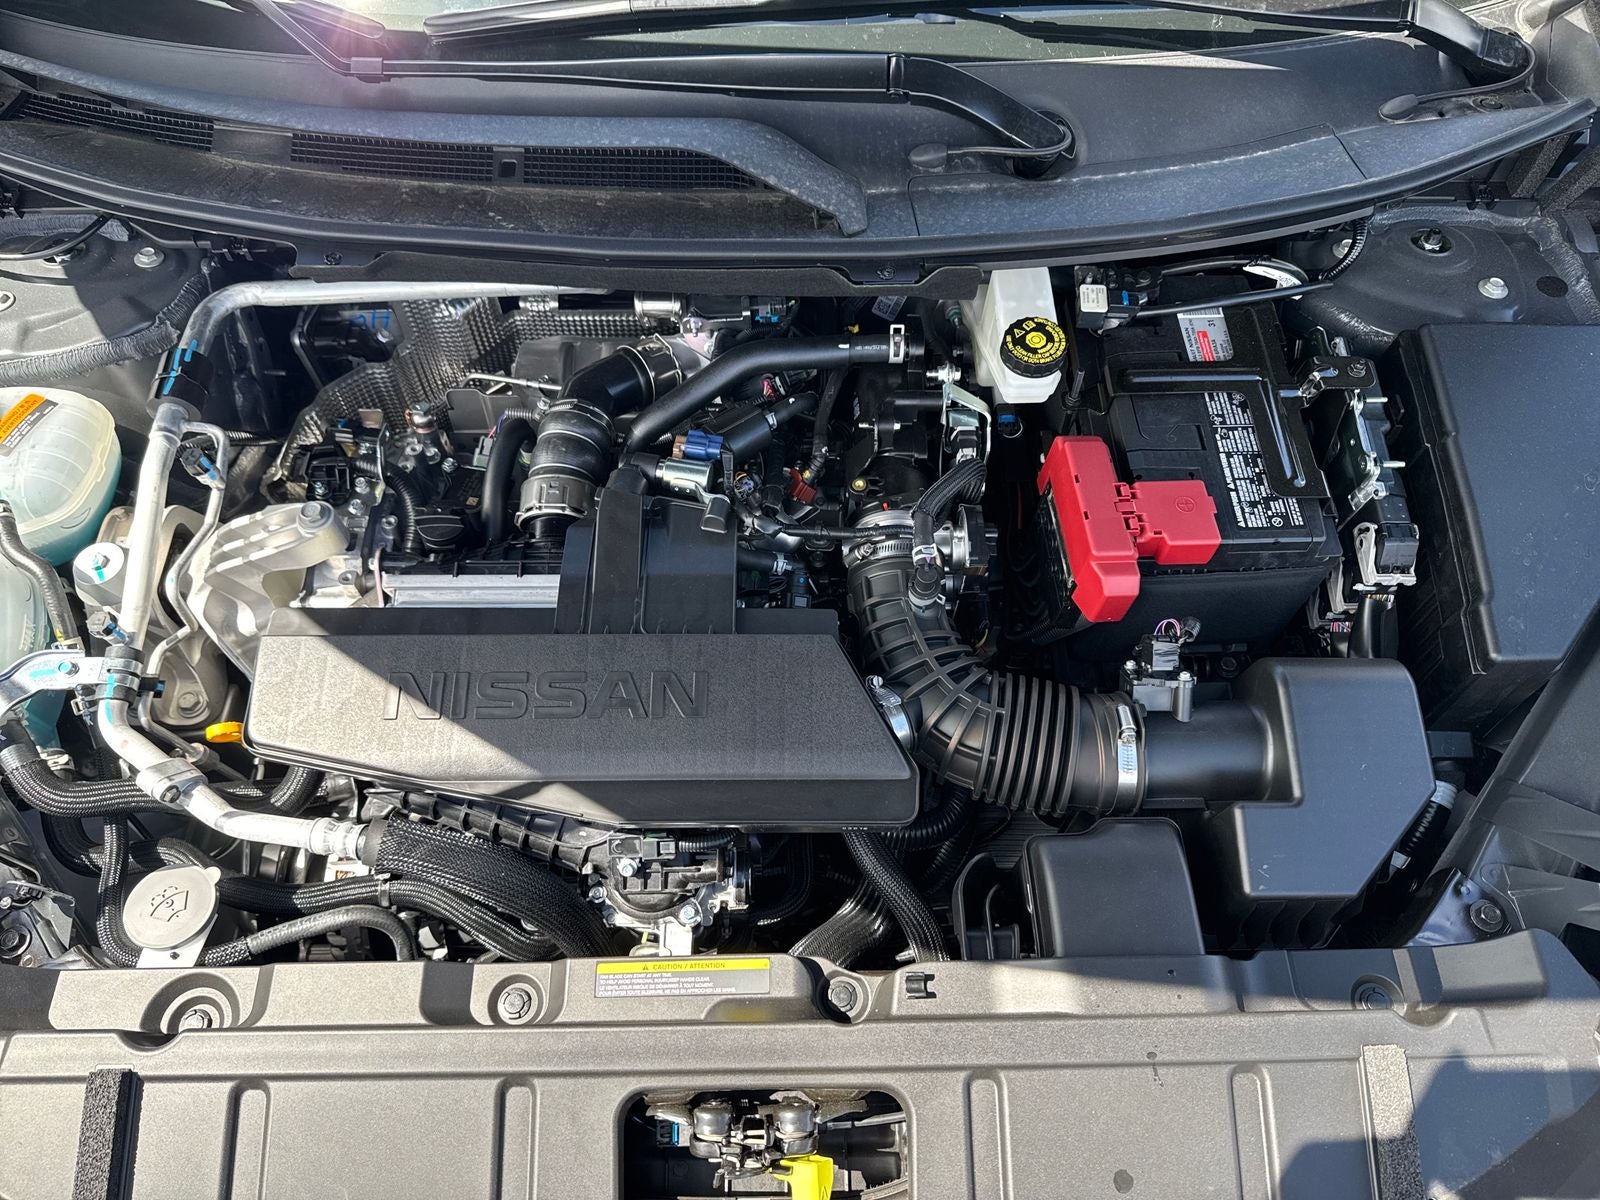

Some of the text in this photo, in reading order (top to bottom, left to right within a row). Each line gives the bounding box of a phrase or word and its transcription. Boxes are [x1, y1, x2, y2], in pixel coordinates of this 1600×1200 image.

[1207, 320, 1216, 328] 31
[1016, 346, 1027, 355] CLEAN
[384, 671, 709, 720] NISSAN
